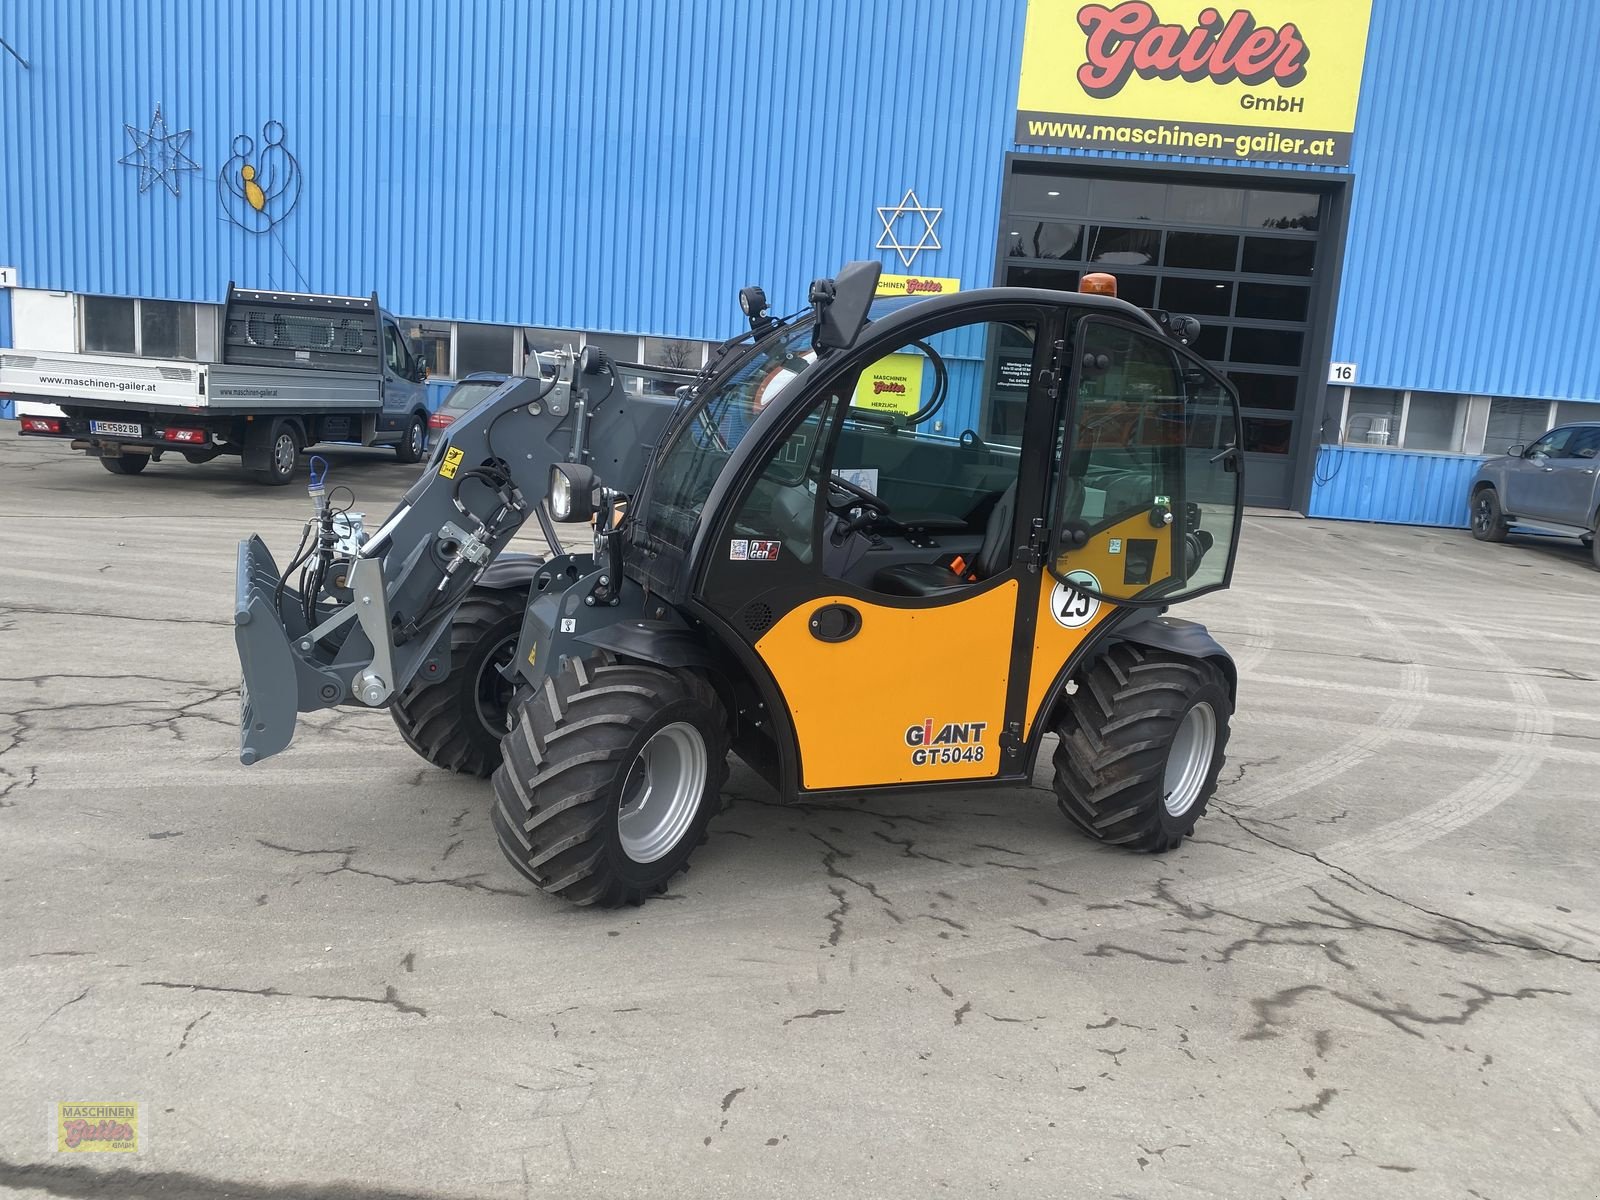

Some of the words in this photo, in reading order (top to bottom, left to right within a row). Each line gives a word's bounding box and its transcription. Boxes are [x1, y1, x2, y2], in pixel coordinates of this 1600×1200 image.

[1077, 0, 1310, 99] Gailer
[1240, 94, 1304, 113] GmbH
[1028, 119, 1335, 156] www.maschinen-gailer.at
[877, 281, 906, 289] CHINEN
[906, 278, 942, 294] Gailer
[1335, 366, 1352, 380] 16
[39, 375, 157, 392] www.maschinen-gailer.at
[1060, 577, 1093, 617] 25
[912, 746, 984, 765] GT5048
